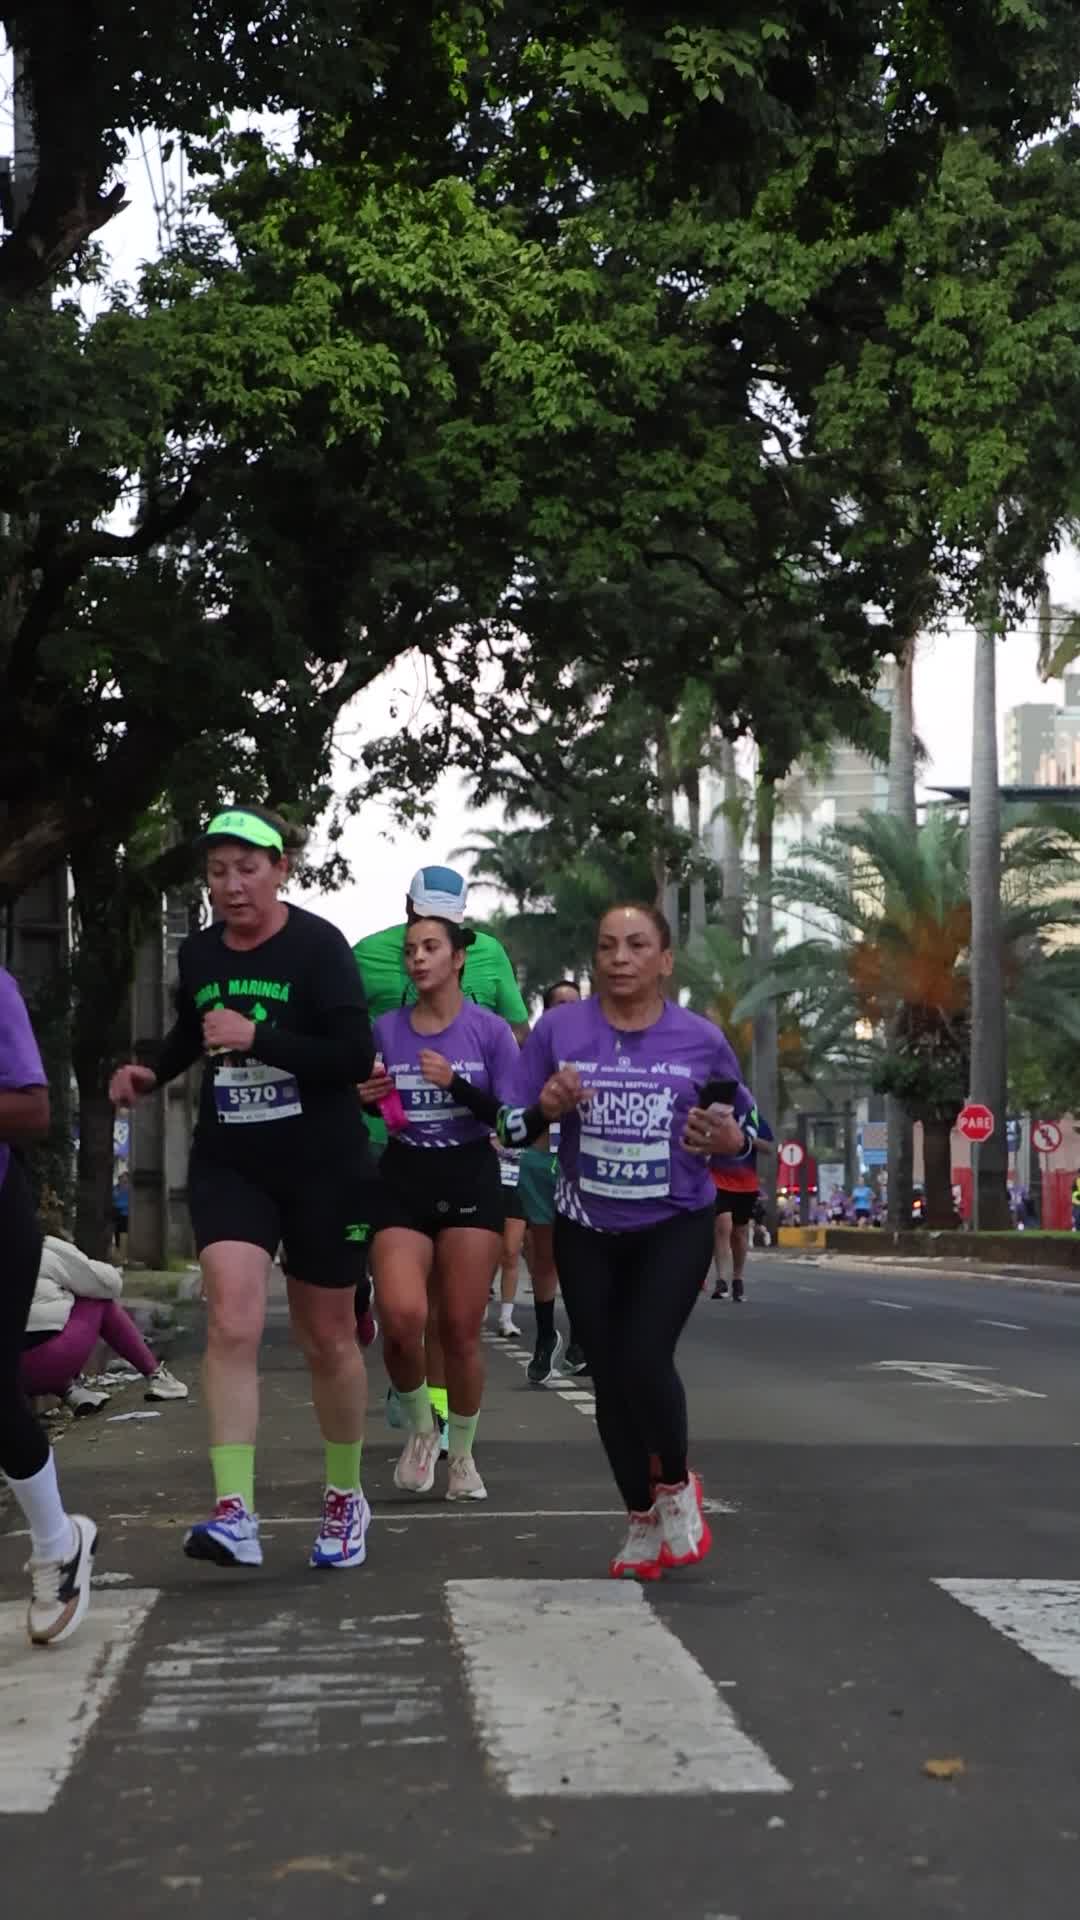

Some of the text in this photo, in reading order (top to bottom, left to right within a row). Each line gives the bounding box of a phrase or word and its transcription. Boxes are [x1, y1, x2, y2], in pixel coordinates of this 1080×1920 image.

[228, 979, 292, 1002] MARINGÁ
[228, 1085, 278, 1105] 5570
[411, 1089, 455, 1105] 5132
[960, 1116, 991, 1130] PARE
[596, 1159, 649, 1179] 5744
